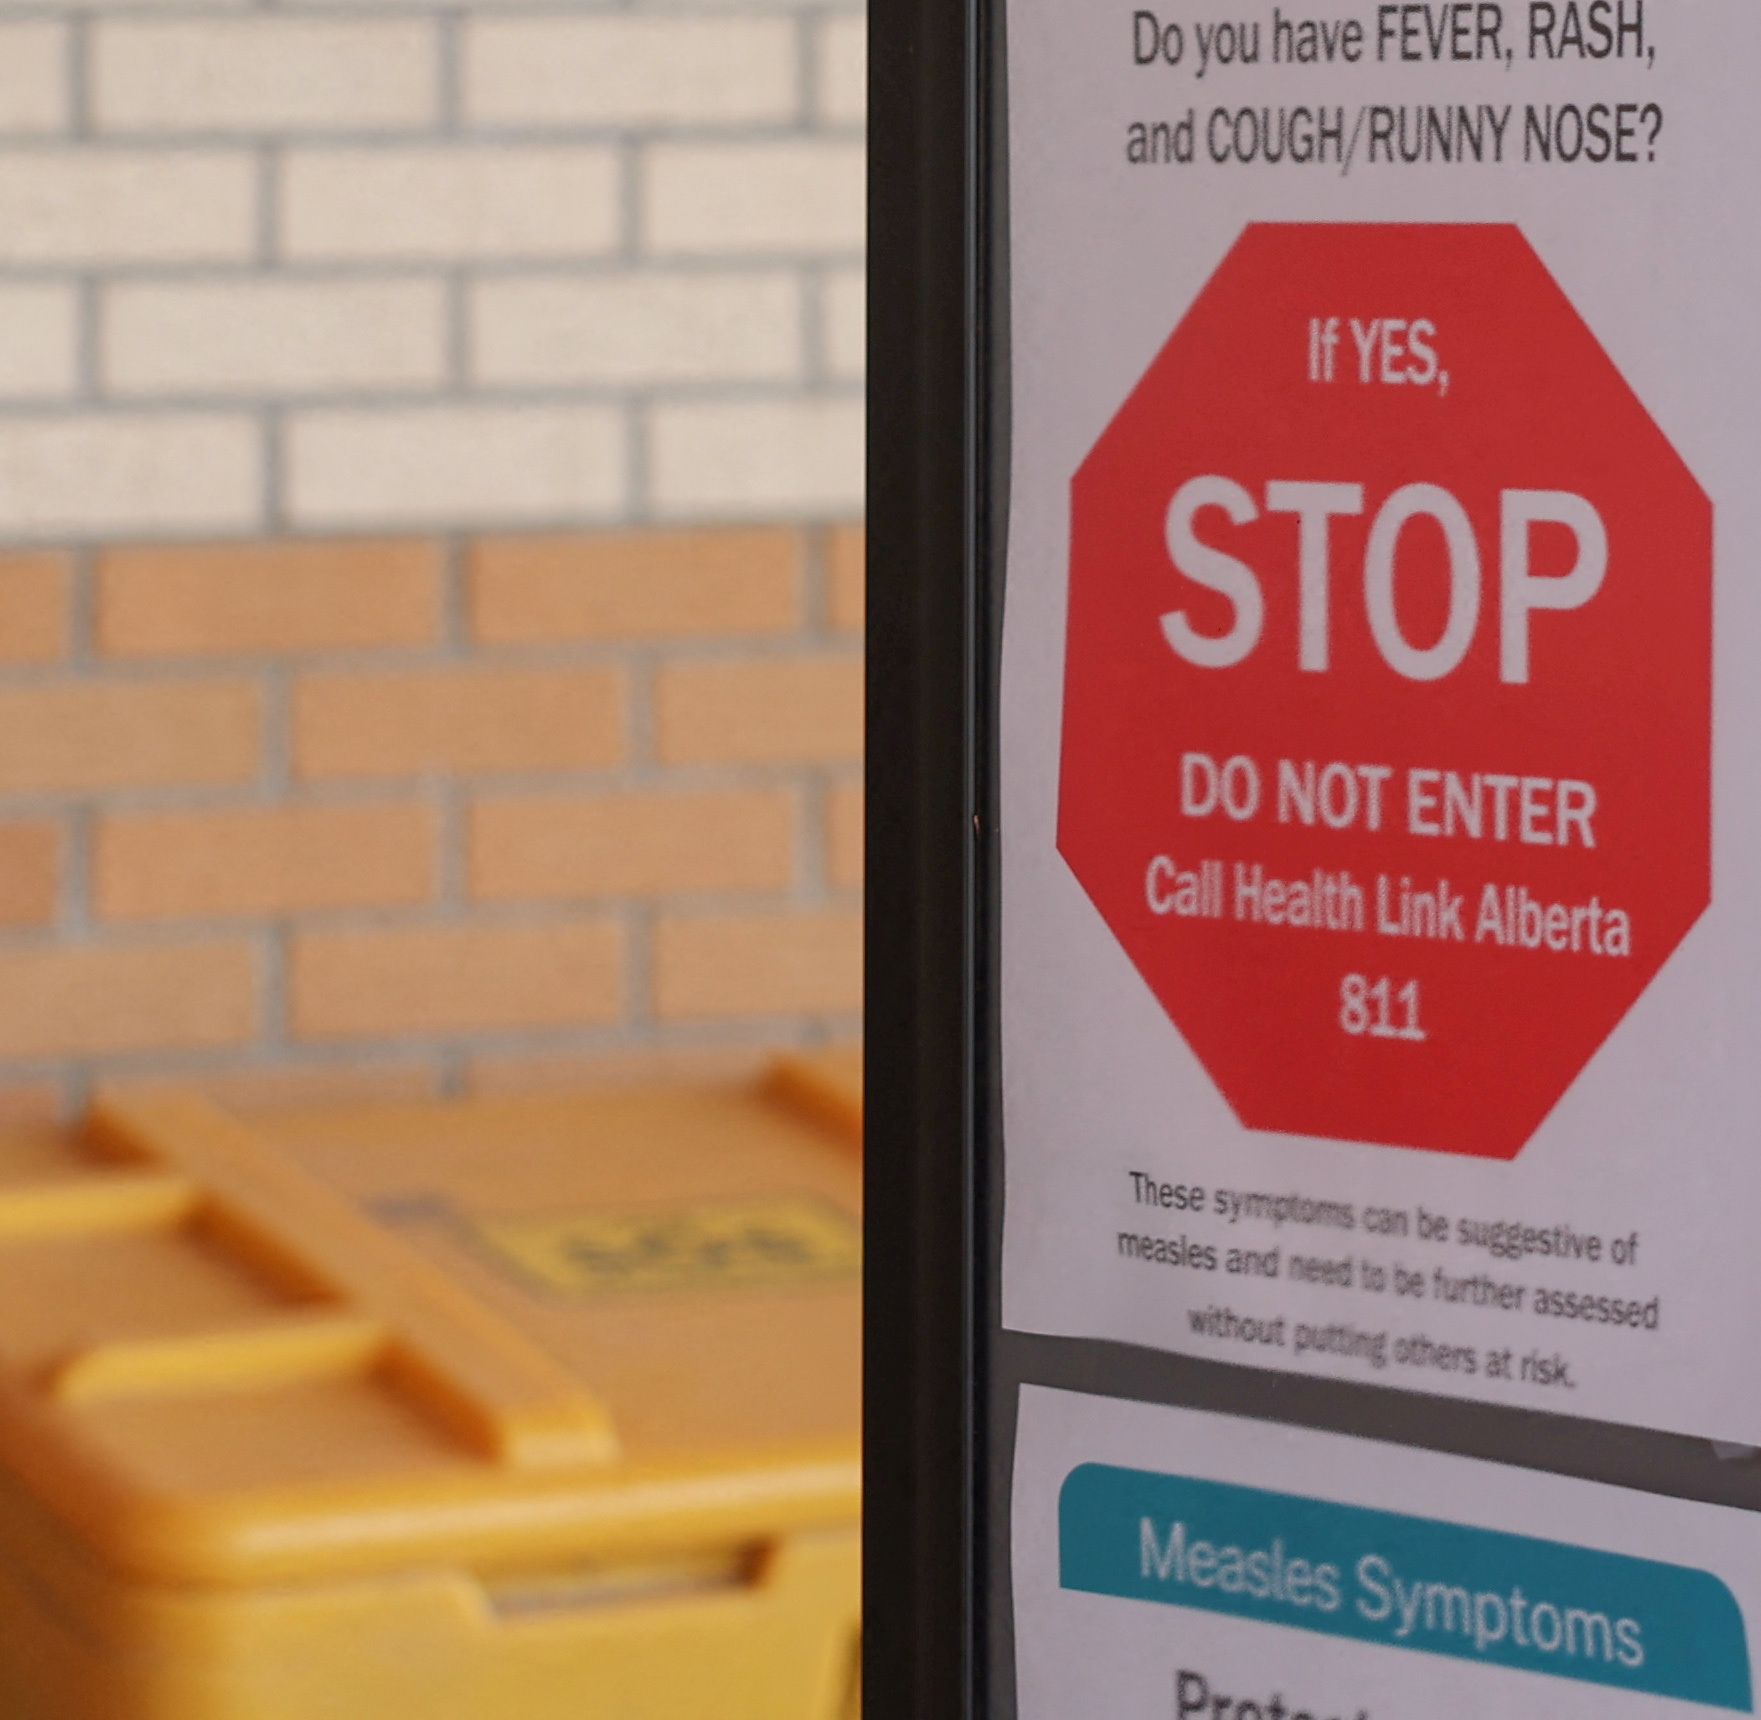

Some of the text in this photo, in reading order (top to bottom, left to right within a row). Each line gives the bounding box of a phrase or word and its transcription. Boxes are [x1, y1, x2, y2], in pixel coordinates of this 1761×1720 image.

[1133, 0, 1654, 79] Do you have FEVER, RASH,
[1127, 103, 1662, 176] and COUGH/RUNNY NOSE?
[1310, 318, 1449, 396] If YES,
[1160, 475, 1608, 684] STOP
[1182, 753, 1596, 847] DO NOT ENTER
[1147, 856, 1629, 956] Call Health Link Alberta
[1340, 974, 1425, 1040] 811
[1129, 1171, 1638, 1266] These symptoms can be suggestive of
[1118, 1232, 1659, 1331] measles and need to be further assessed
[1188, 1305, 1576, 1388] without putting others at risk.
[1140, 1517, 1644, 1666] Measles Symptoms
